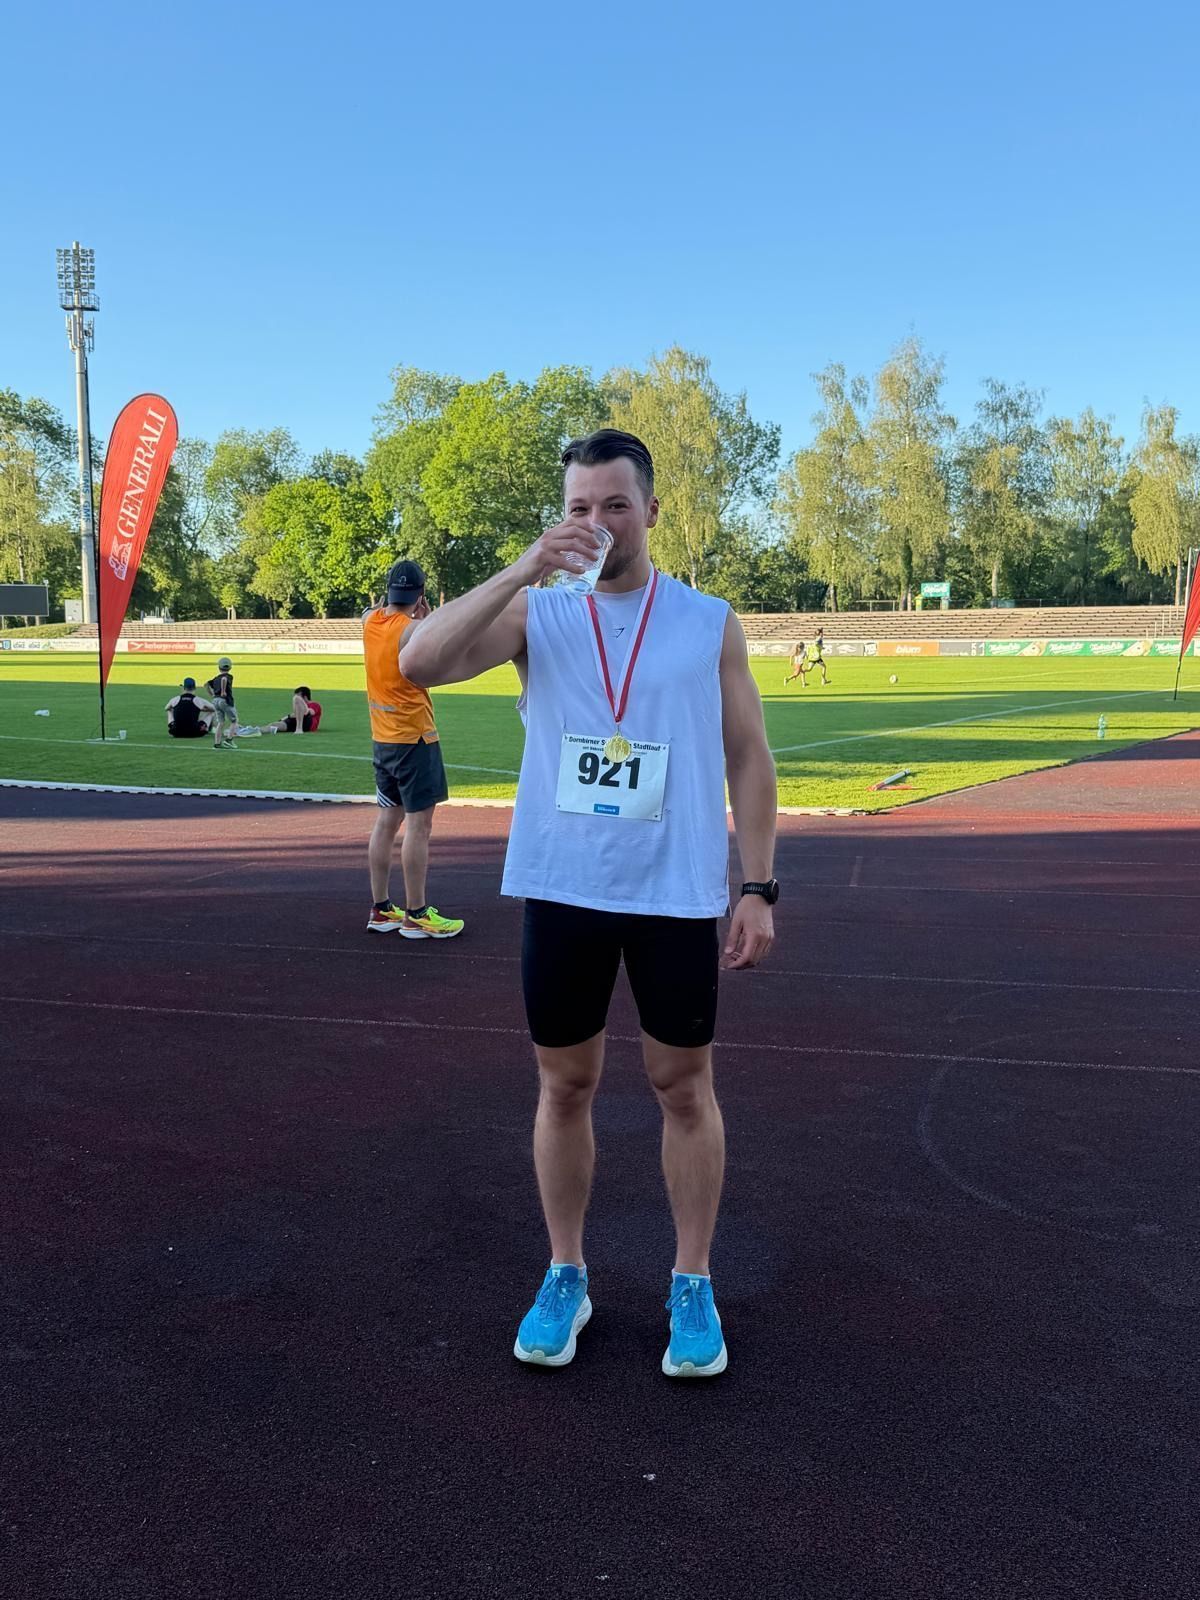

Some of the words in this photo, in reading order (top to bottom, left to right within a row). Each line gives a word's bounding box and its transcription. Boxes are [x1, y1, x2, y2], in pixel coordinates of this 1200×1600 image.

[117, 407, 168, 538] GENERALI
[895, 645, 922, 654] blum
[568, 736, 600, 746] Dornbirner
[633, 743, 661, 752] Stadtlauf
[577, 752, 641, 790] 921
